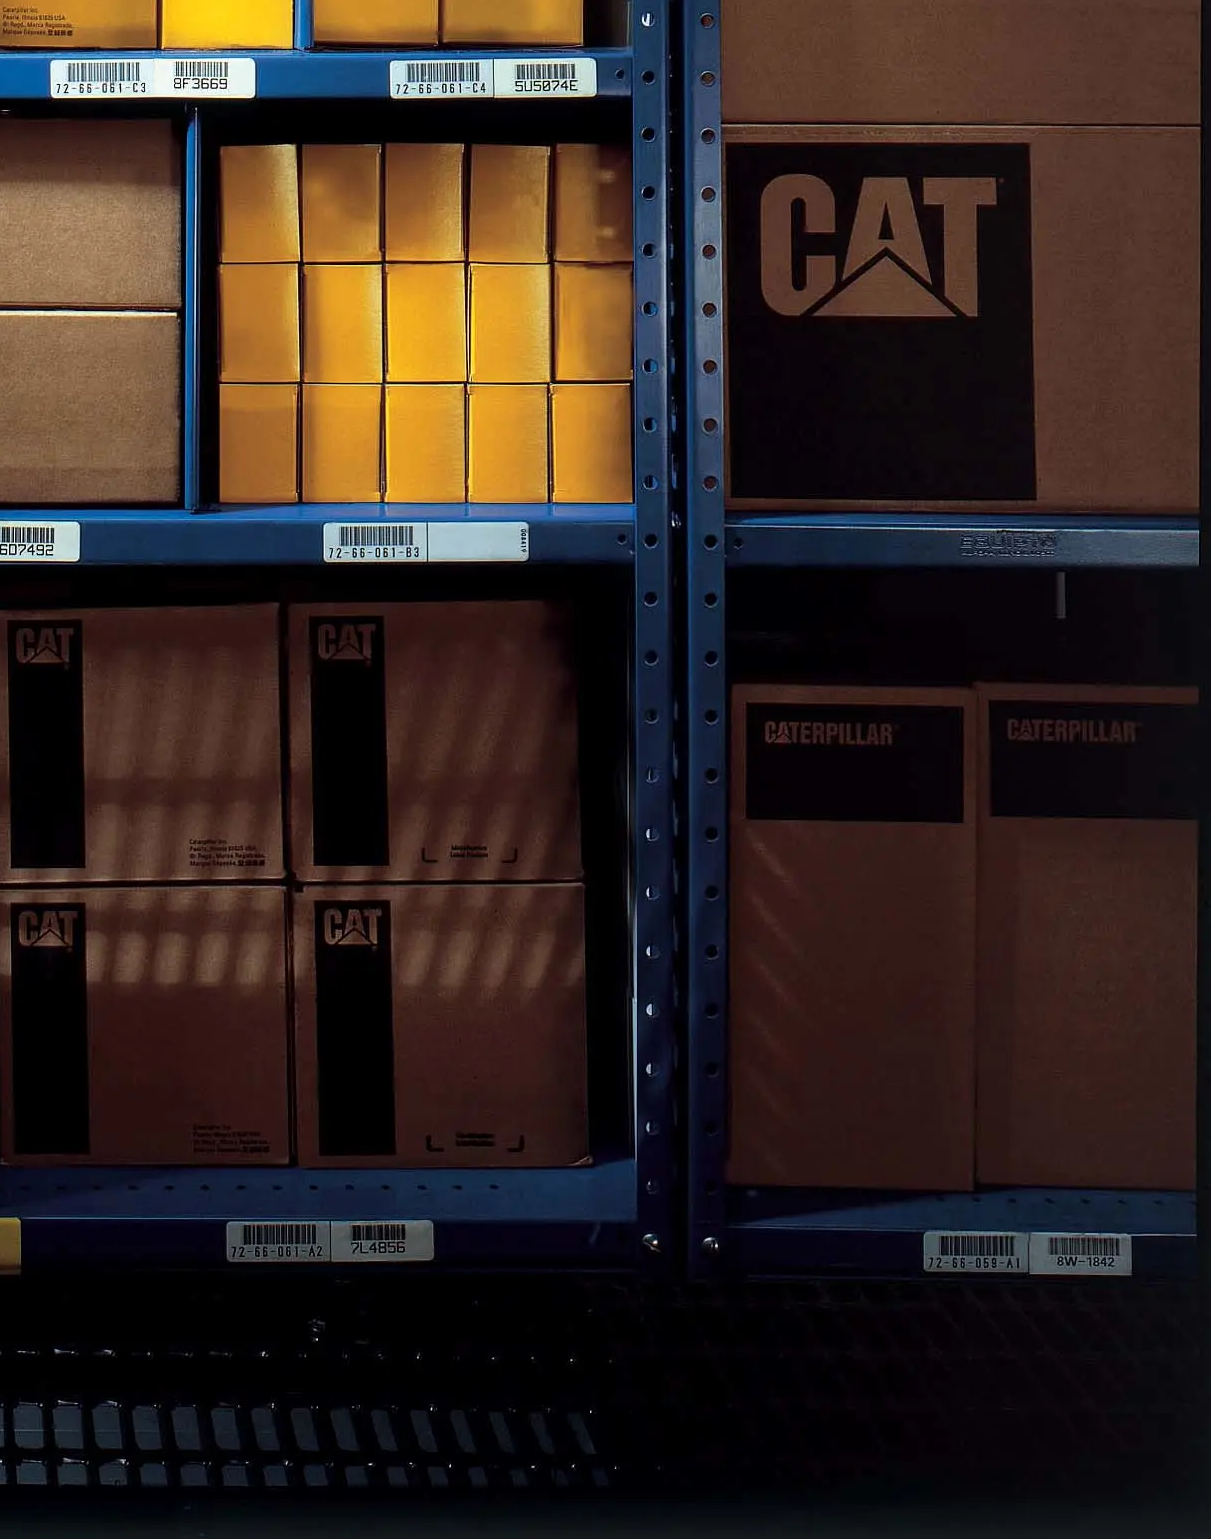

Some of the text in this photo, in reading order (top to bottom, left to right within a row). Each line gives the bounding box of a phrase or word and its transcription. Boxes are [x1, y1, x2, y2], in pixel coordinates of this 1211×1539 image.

[56, 82, 146, 93] 72-66-061-C3
[174, 77, 228, 89] 8F3669
[396, 82, 486, 93] 72-66-061-C4
[759, 174, 997, 317] CAT
[329, 546, 419, 558] 72-66-061-B3
[15, 627, 74, 664] CAT
[317, 623, 375, 660] CAT
[764, 721, 893, 745] CATERPILLAR
[1007, 718, 1136, 742] CATERPILLAR
[18, 910, 78, 948] CAT
[323, 907, 382, 948] CAT
[232, 1245, 322, 1257] 72-66-061-A2
[351, 1241, 405, 1254] 7L4856
[929, 1256, 1020, 1268] 72-66-059-A1
[1057, 1255, 1115, 1266] 8W-1842
